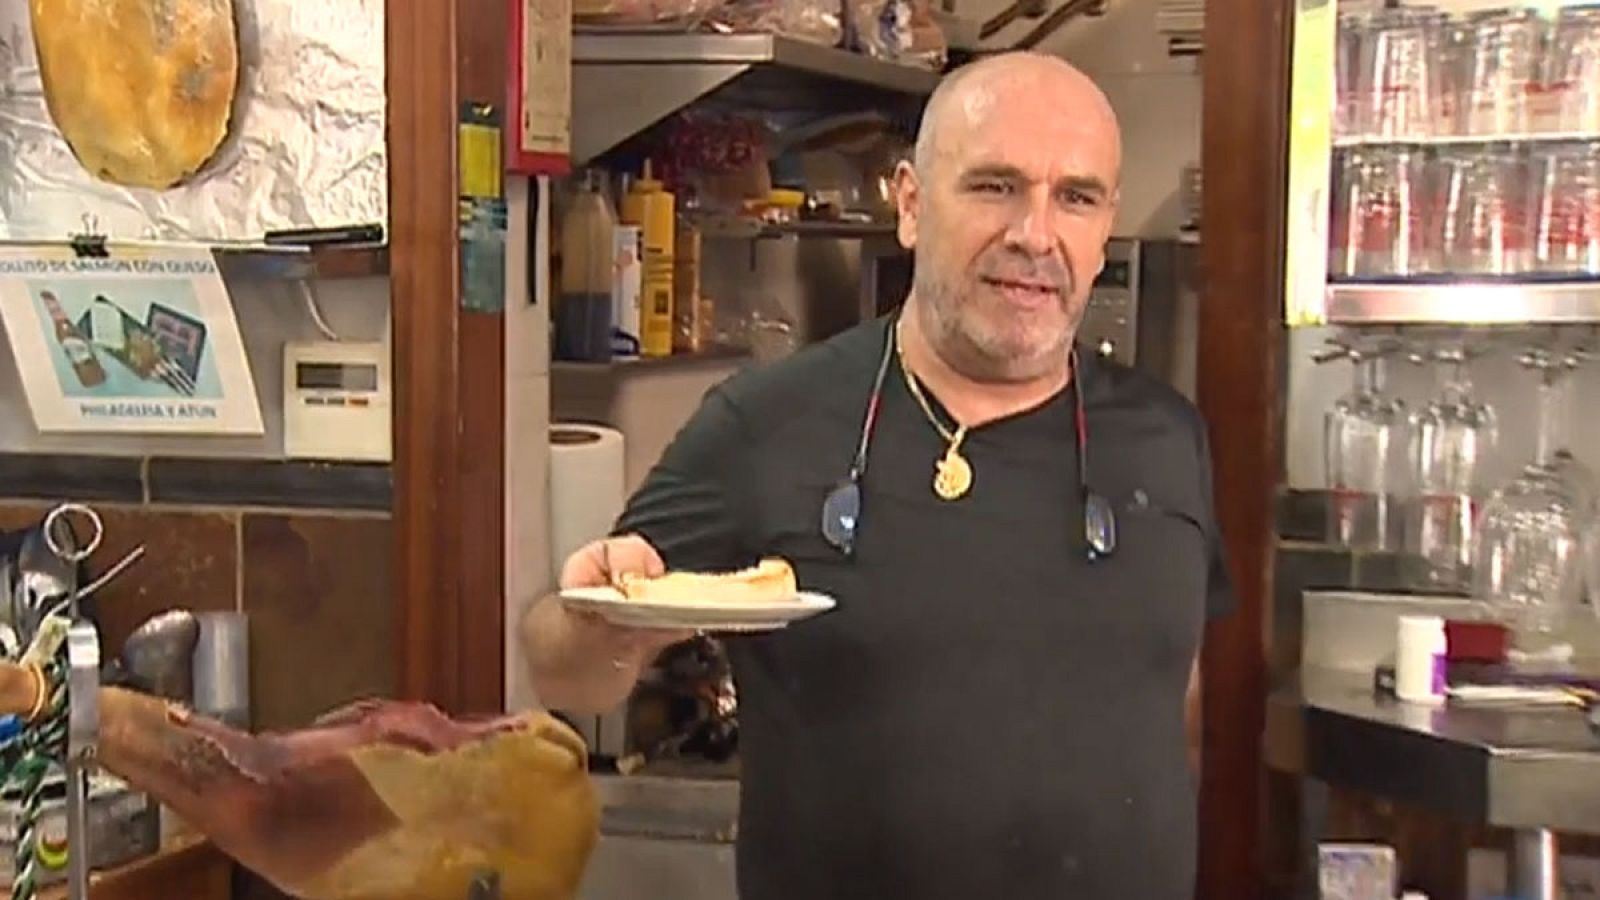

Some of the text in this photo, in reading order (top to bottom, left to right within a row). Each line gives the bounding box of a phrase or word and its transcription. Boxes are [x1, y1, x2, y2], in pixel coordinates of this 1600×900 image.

[50, 260, 65, 272] DE
[132, 260, 164, 273] CON
[166, 260, 214, 273] QUESO
